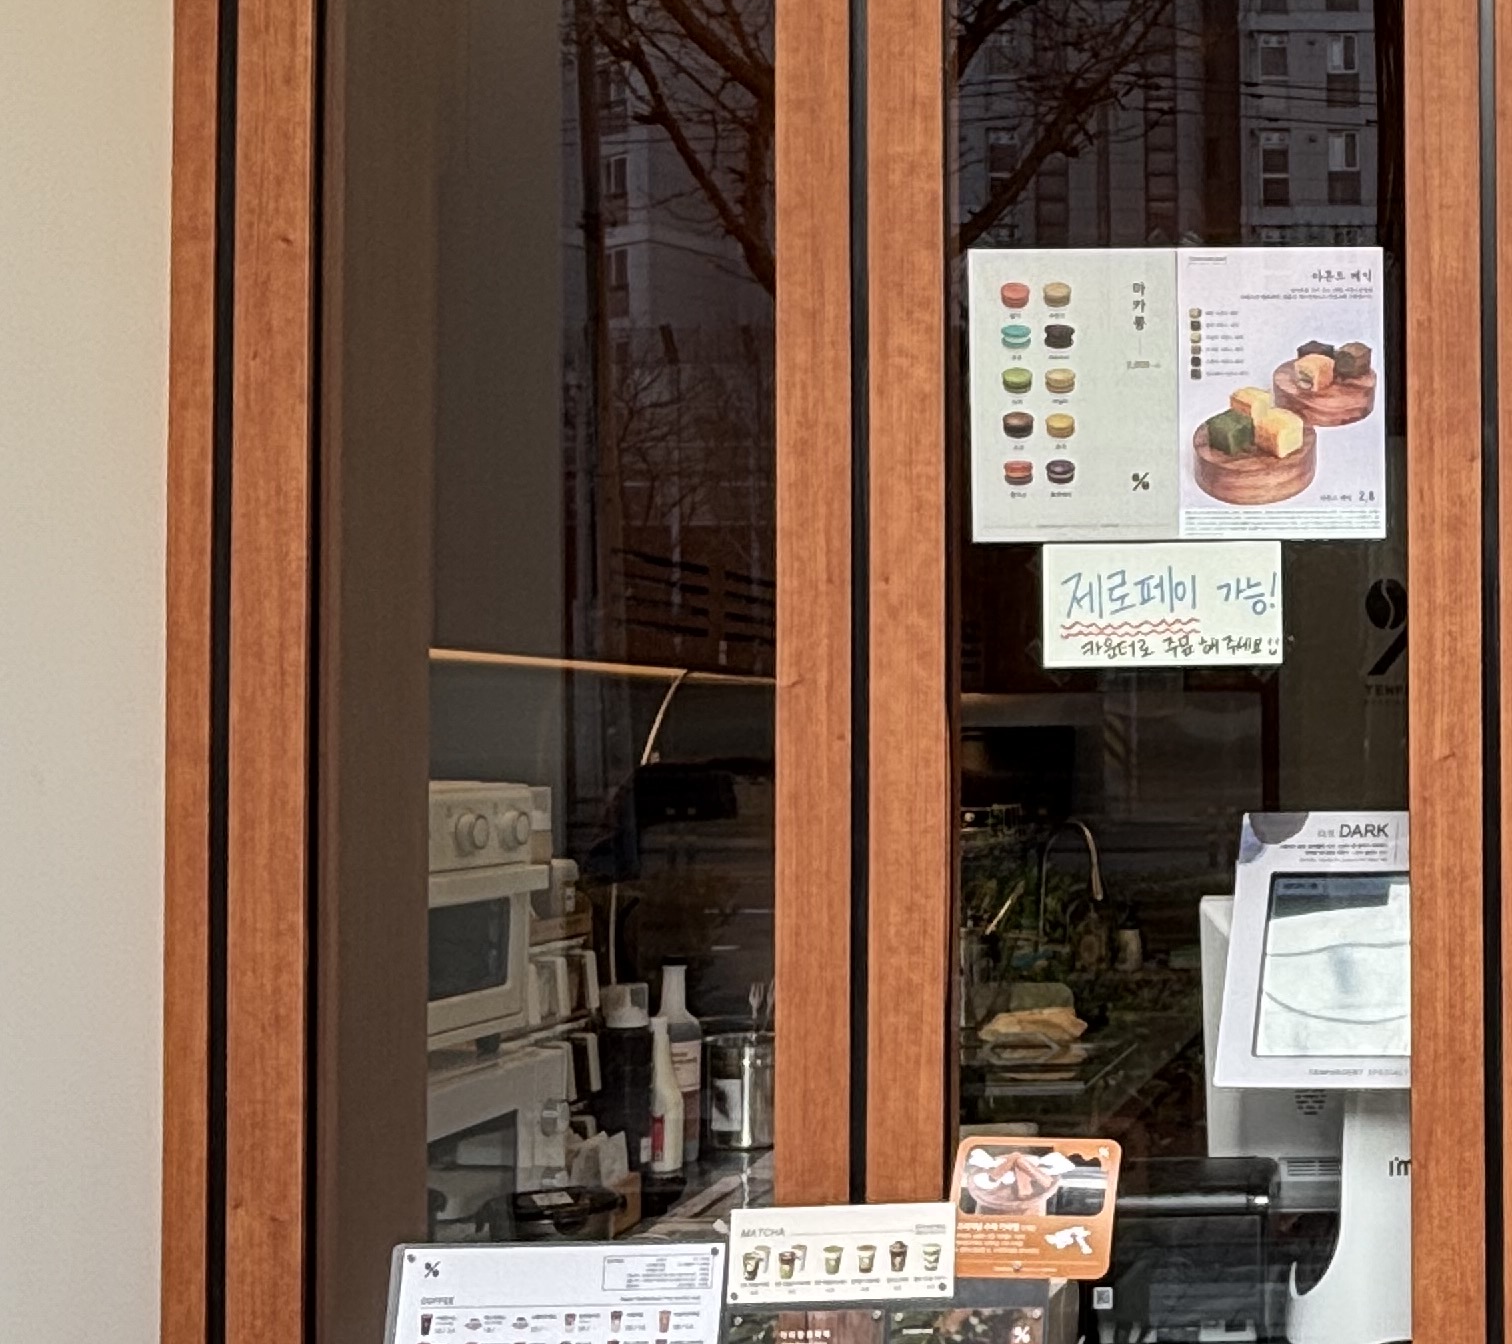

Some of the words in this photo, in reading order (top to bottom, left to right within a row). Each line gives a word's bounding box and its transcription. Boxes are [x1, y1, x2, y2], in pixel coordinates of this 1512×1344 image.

[1060, 565, 1197, 618] 제로페이
[1216, 571, 1277, 616] 가능!
[1339, 823, 1389, 838] DARK
[740, 1227, 786, 1239] MATCHA
